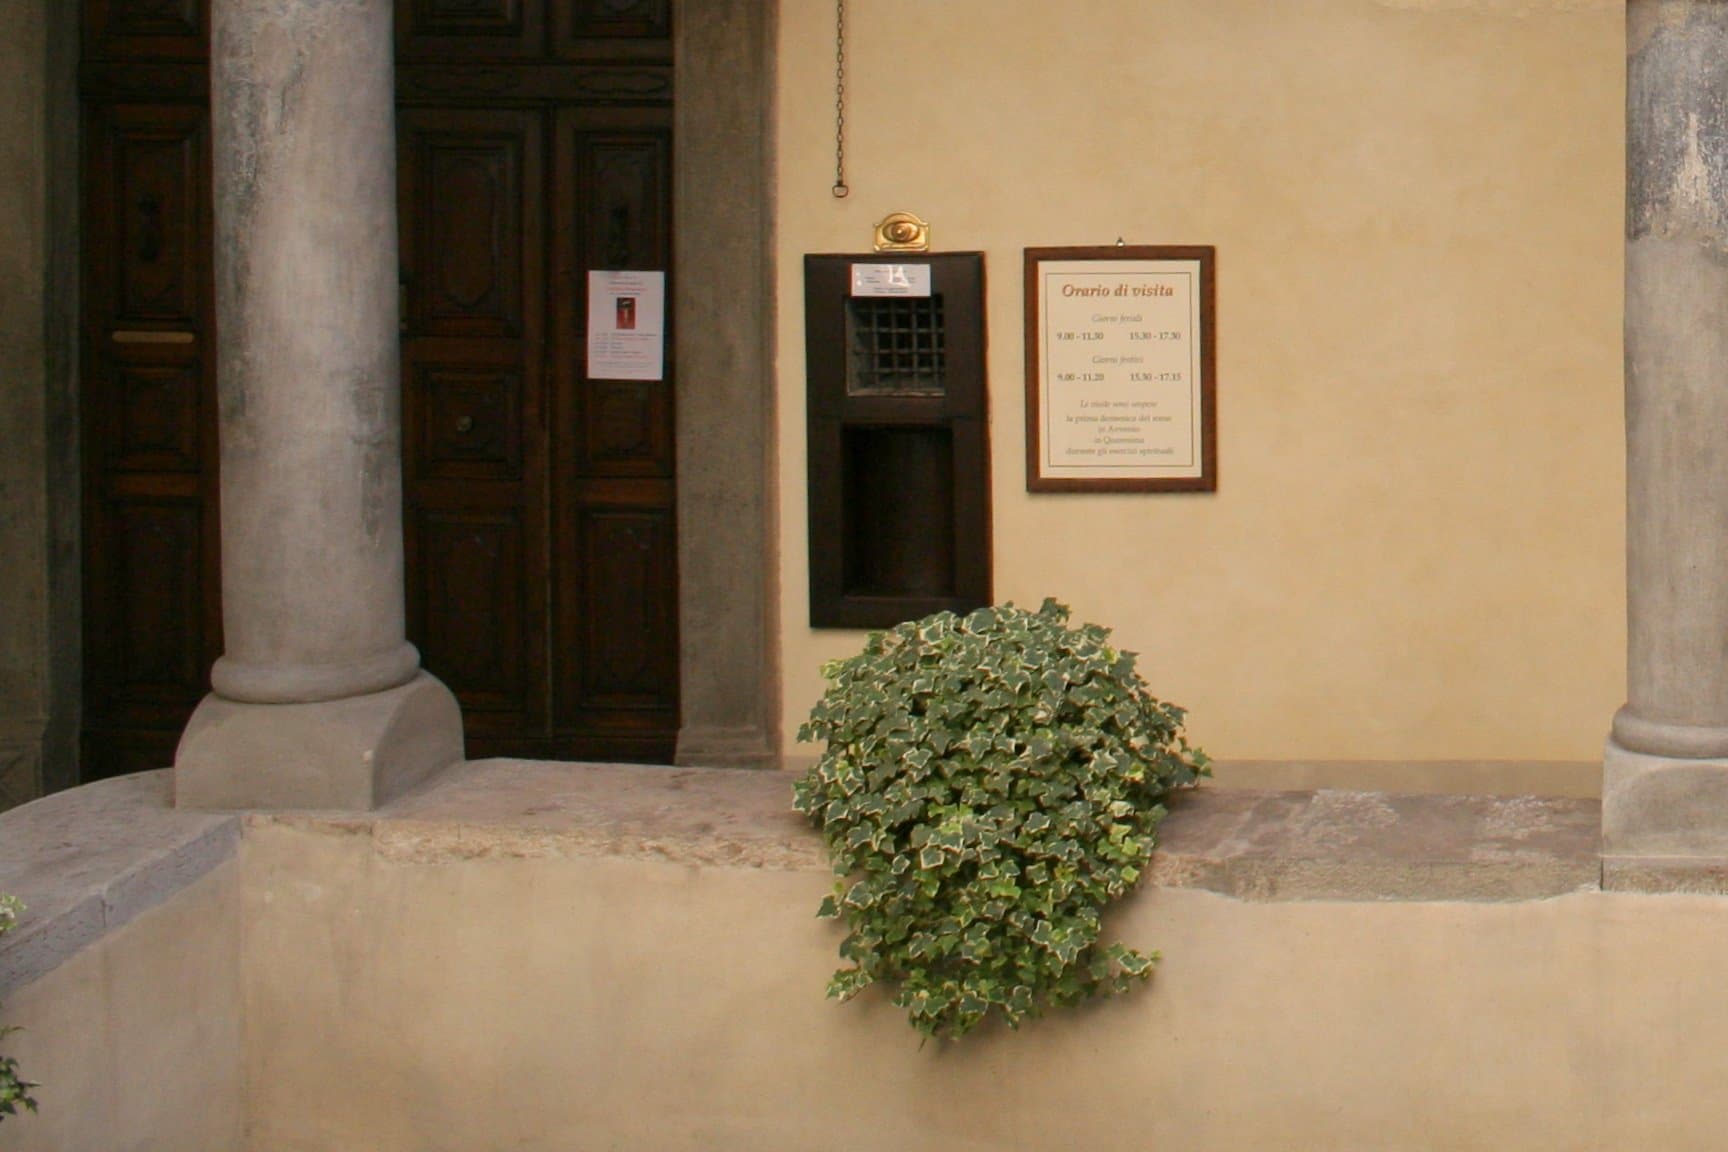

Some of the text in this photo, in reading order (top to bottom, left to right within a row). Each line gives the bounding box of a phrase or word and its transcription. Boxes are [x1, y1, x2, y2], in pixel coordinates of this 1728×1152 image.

[1062, 283, 1174, 298] Orario di visita
